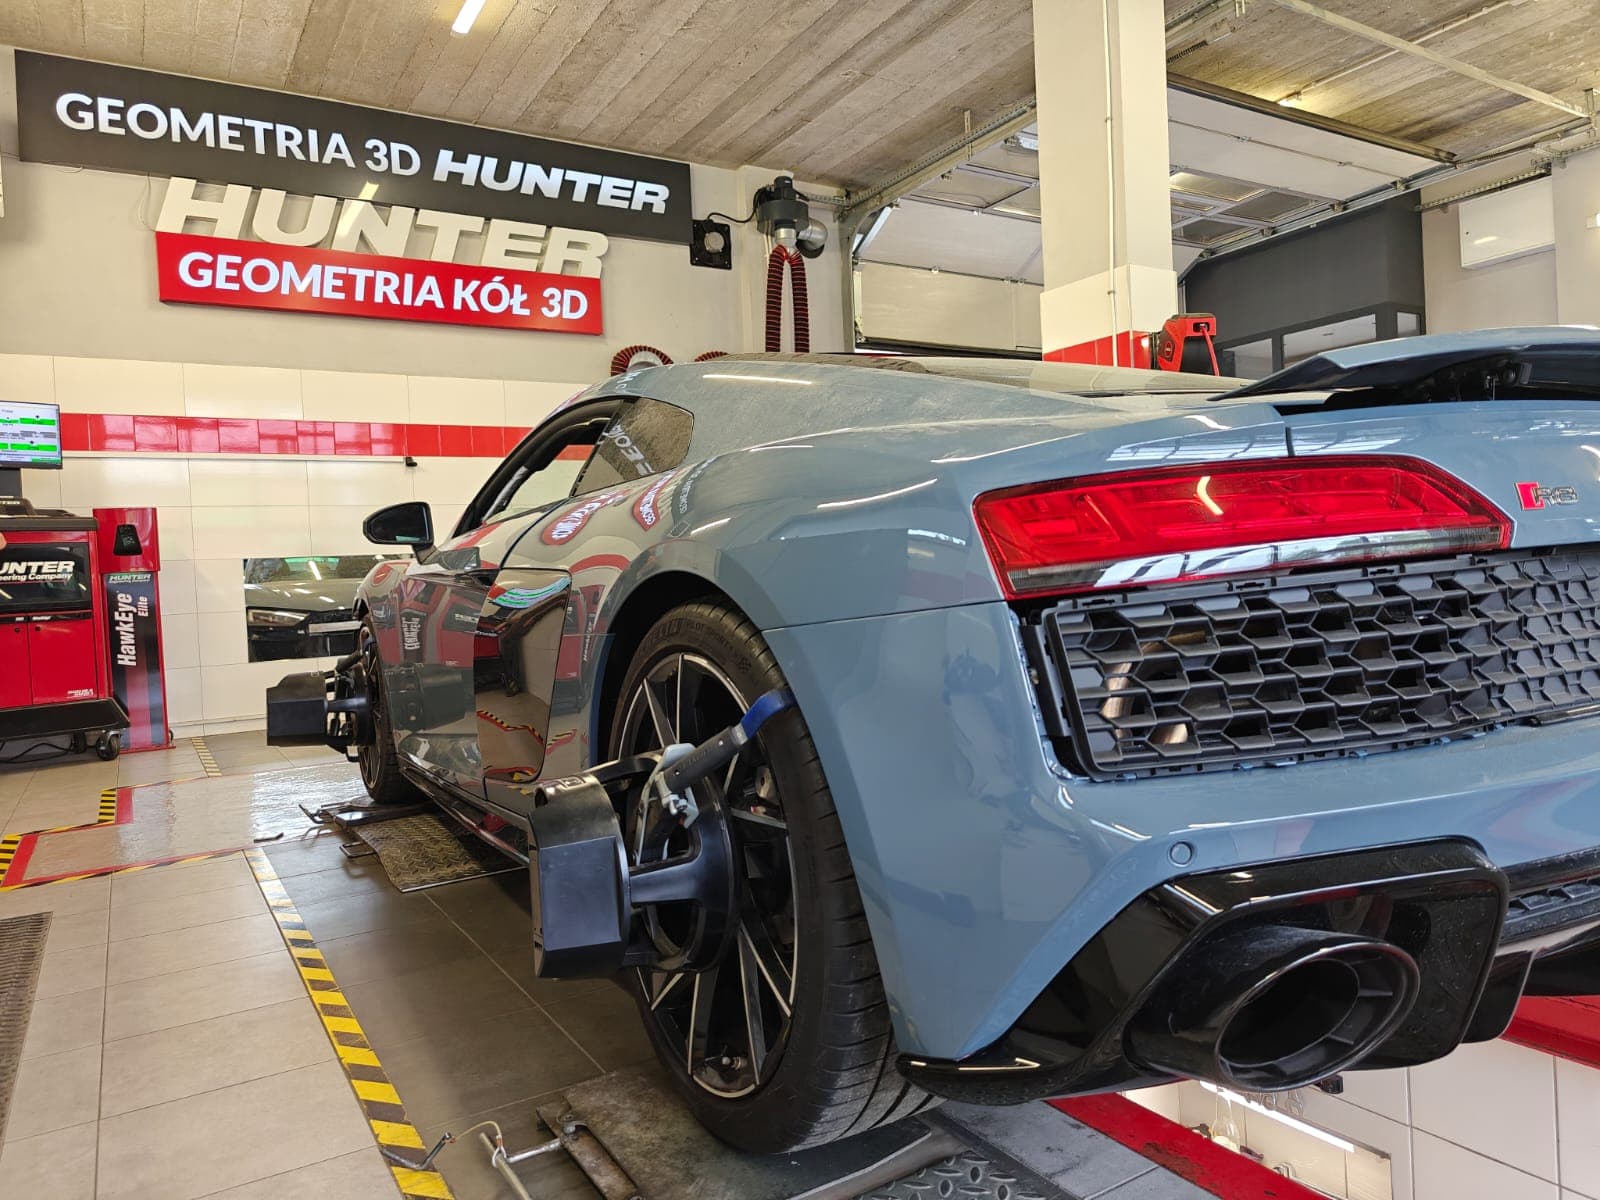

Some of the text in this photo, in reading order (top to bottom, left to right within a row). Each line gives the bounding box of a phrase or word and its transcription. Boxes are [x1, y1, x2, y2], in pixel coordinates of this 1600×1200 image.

[55, 92, 670, 214] GEOMETRIA 3D HUNTER
[155, 176, 609, 279] HUNTER
[178, 251, 589, 320] GEOMETRIA KÓŁ 3D
[28, 573, 73, 582] Company
[108, 573, 152, 582] HUNTER
[137, 596, 149, 617] Elite
[114, 593, 137, 666] HawkEye
